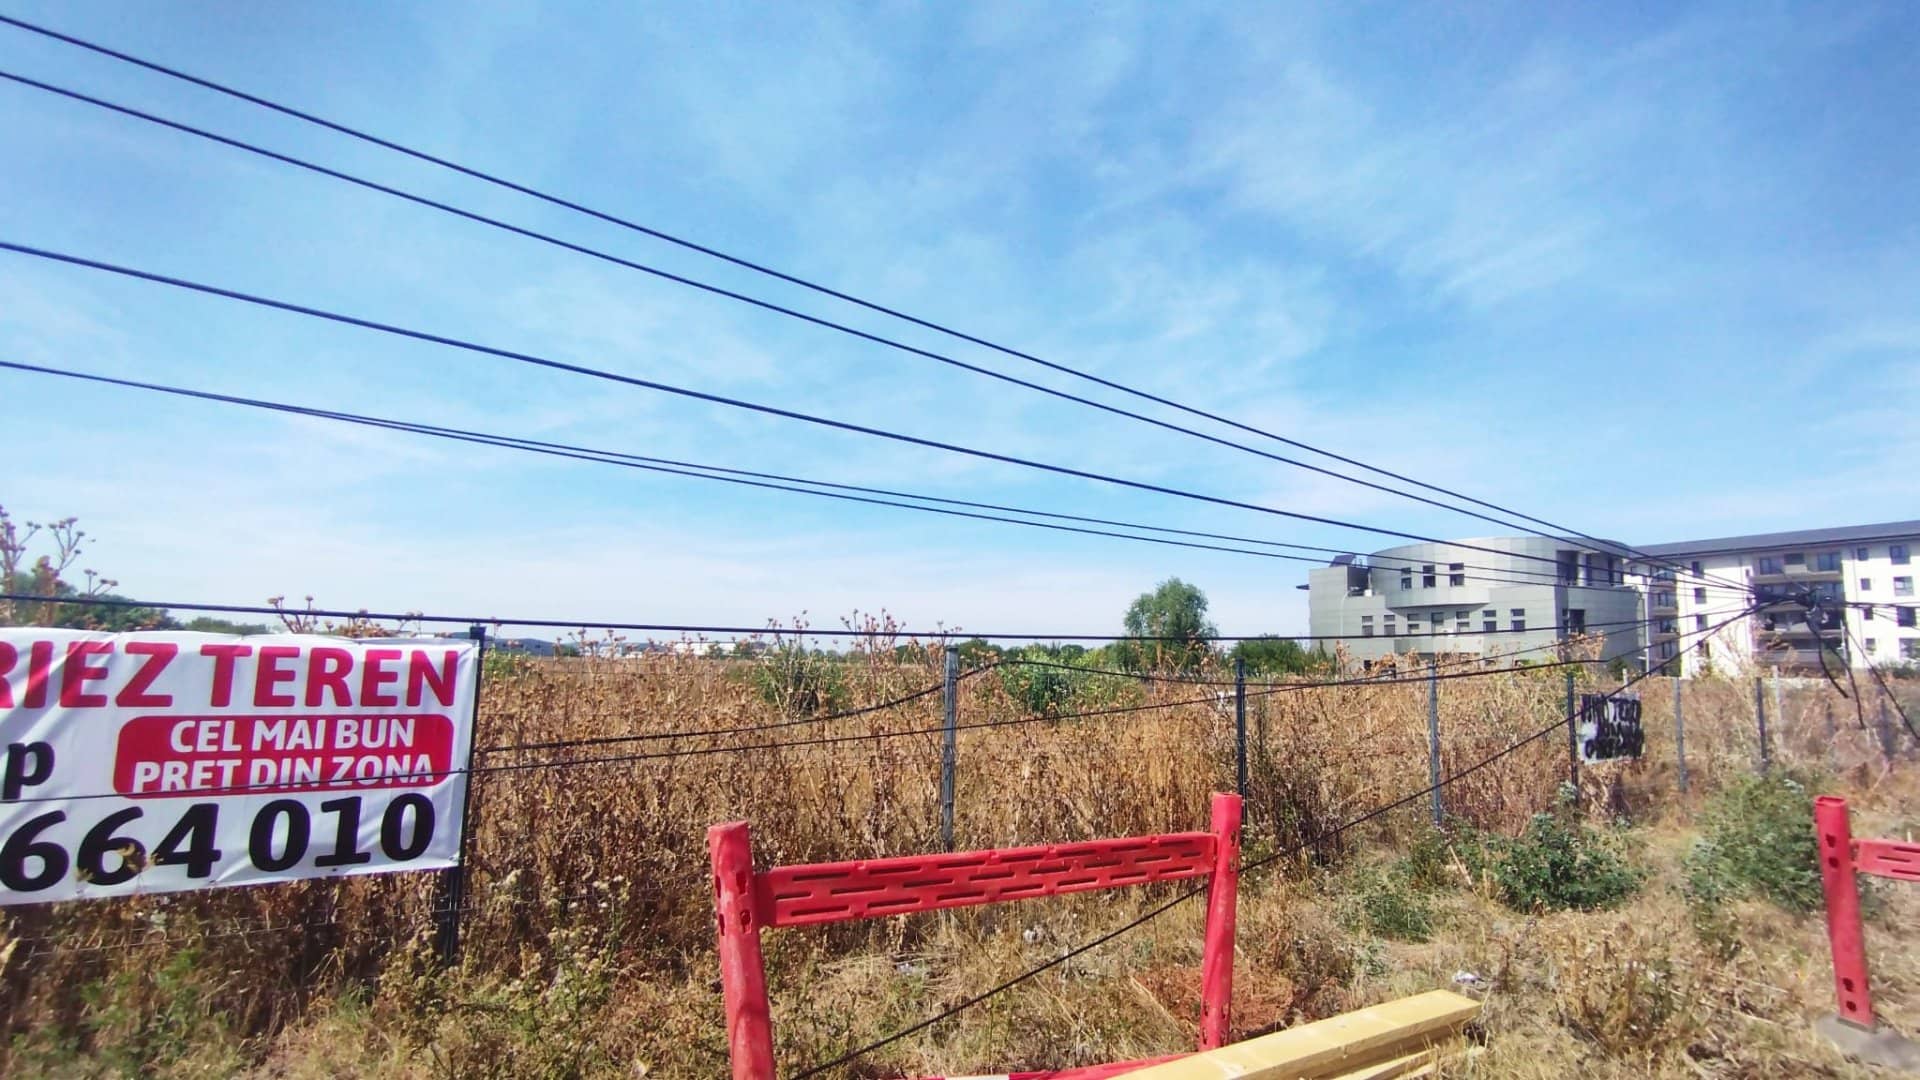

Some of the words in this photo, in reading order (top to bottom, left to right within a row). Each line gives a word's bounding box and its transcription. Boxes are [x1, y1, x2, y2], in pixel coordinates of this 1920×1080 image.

[201, 644, 458, 707] TEREN
[171, 720, 242, 752] CEL
[252, 719, 326, 751] MAI
[334, 718, 415, 750] BUN
[132, 759, 242, 793] PRET
[248, 756, 322, 790] DIN
[327, 754, 434, 785] ZONA
[0, 803, 222, 892] 664
[249, 793, 435, 872] 010
